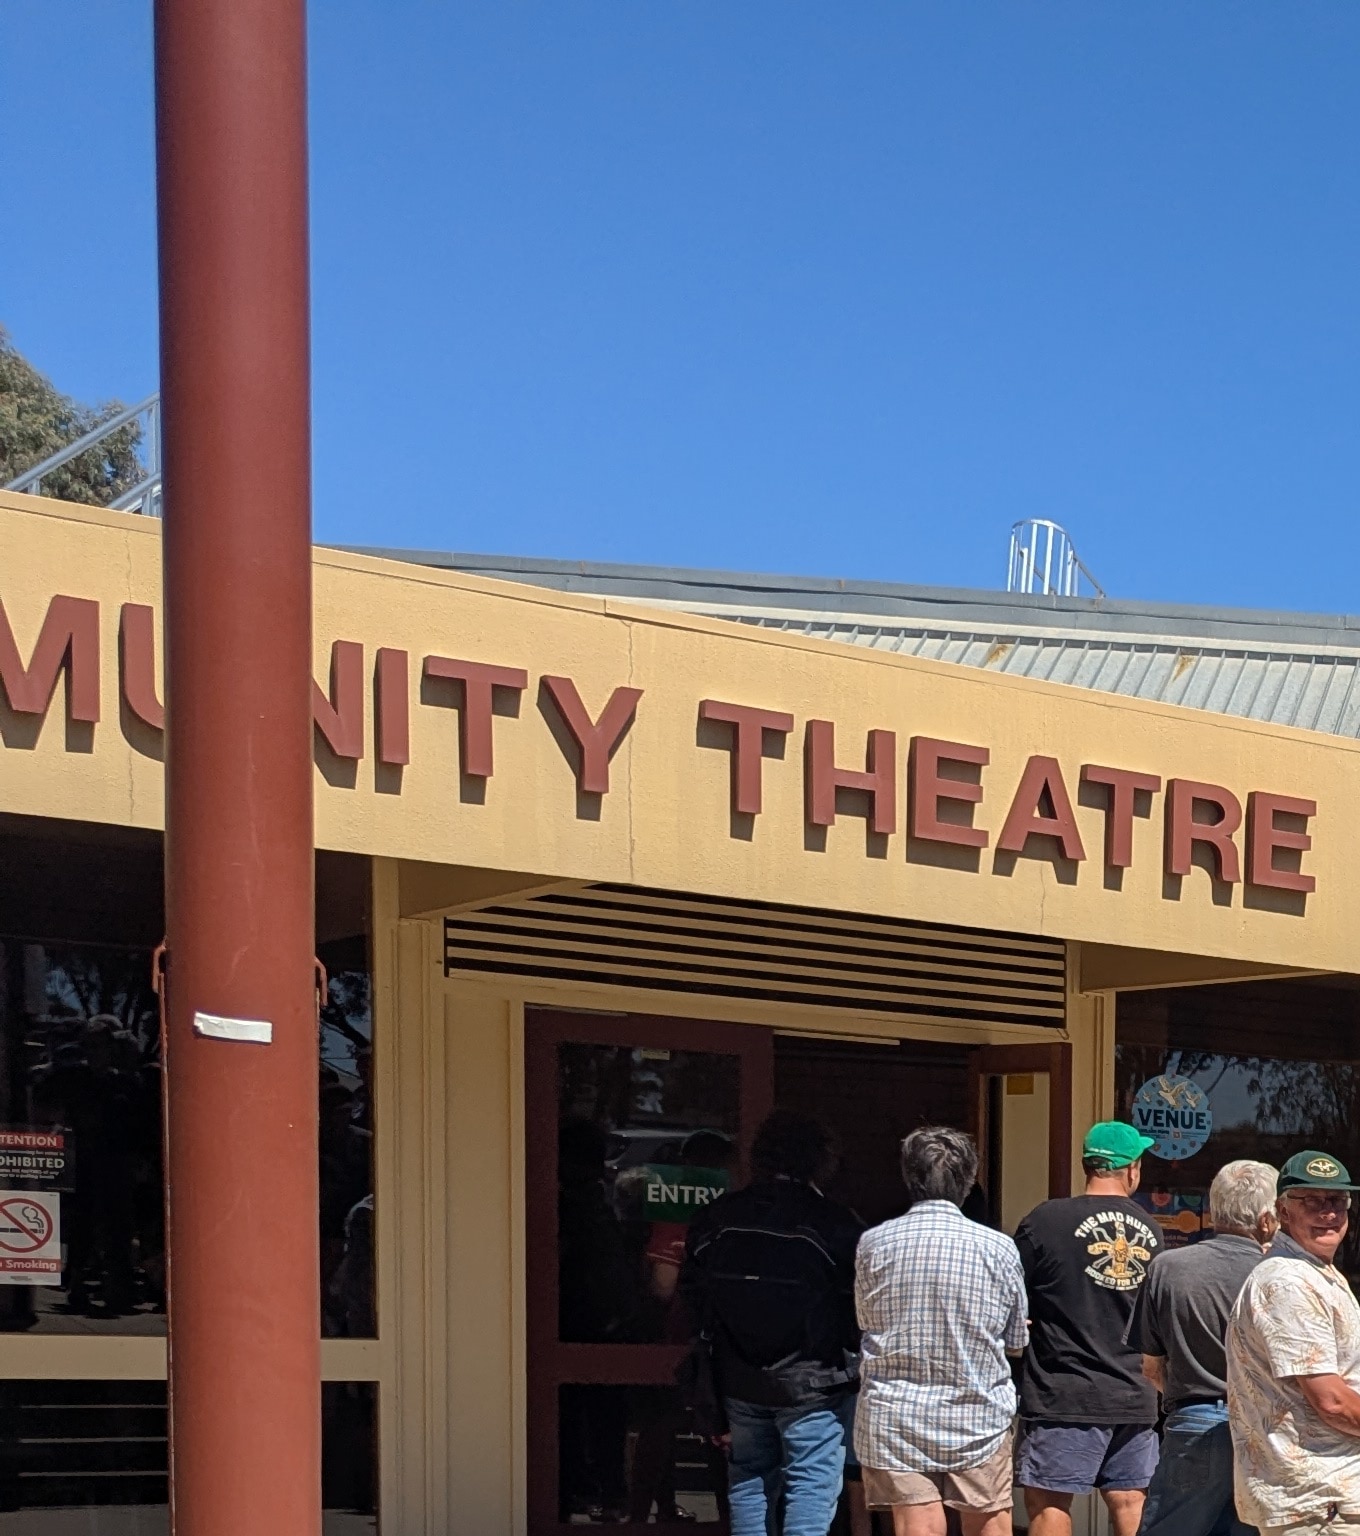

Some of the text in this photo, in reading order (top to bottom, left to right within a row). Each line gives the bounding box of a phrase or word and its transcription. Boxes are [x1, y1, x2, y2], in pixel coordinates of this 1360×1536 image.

[700, 700, 1317, 893] THEATRE
[1138, 1108, 1206, 1129] VENUE
[647, 1183, 725, 1205] ENTRY
[1074, 1216, 1098, 1238] THE
[1096, 1212, 1124, 1223] MAD
[1126, 1214, 1157, 1247] HUEYS
[6, 1260, 57, 1271] Smoking
